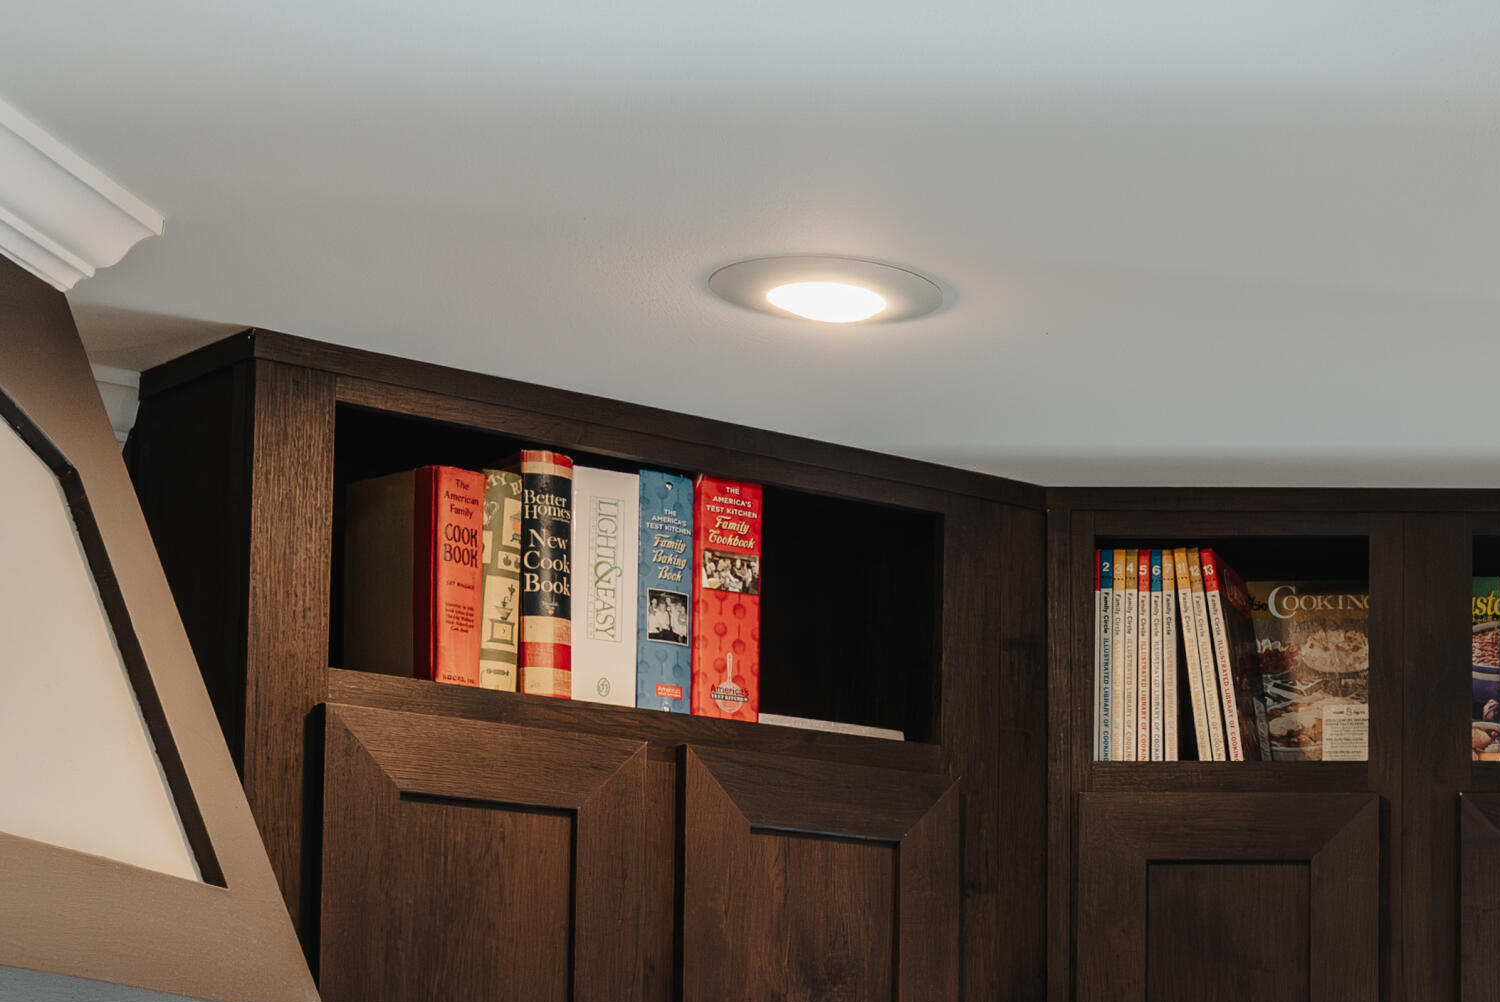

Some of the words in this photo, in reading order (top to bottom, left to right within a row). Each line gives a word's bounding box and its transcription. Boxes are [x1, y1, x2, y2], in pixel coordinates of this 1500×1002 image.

[456, 479, 470, 490] The
[726, 486, 740, 494] THE
[444, 490, 479, 506] American
[524, 489, 568, 508] Better
[712, 496, 752, 508] AMERICA'S
[450, 504, 474, 520] Family
[524, 504, 571, 520] Homes
[664, 508, 677, 516] THE
[706, 504, 724, 514] TEST
[726, 508, 758, 518] KITCHEN
[652, 515, 687, 526] AMERICA'S
[715, 516, 750, 535] Family
[444, 523, 478, 548] COOK
[646, 522, 662, 530] TEST
[664, 525, 692, 536] KITCHEN
[528, 528, 568, 550] New
[653, 534, 686, 554] Family
[708, 529, 756, 549] Cookbook
[444, 544, 478, 568] BOOK
[524, 550, 570, 574] Cook
[652, 550, 687, 570] Baking
[658, 566, 683, 582] Book
[1102, 562, 1110, 572] 2
[1115, 564, 1122, 573] 3
[1126, 562, 1134, 572] 4
[1138, 565, 1147, 576] 5
[1152, 565, 1160, 576] 6
[1166, 564, 1172, 574] 7
[1190, 566, 1200, 576] 12
[1203, 564, 1214, 575] 13
[524, 573, 570, 596] Book
[1210, 594, 1218, 616] Family
[1214, 617, 1222, 636] Circle
[1218, 640, 1230, 686] ILLUSTRATED
[710, 684, 749, 697] America's
[1224, 688, 1234, 718] LIBRARY
[1104, 719, 1110, 728] OF
[1140, 722, 1147, 730] OF
[1228, 720, 1235, 729] OF
